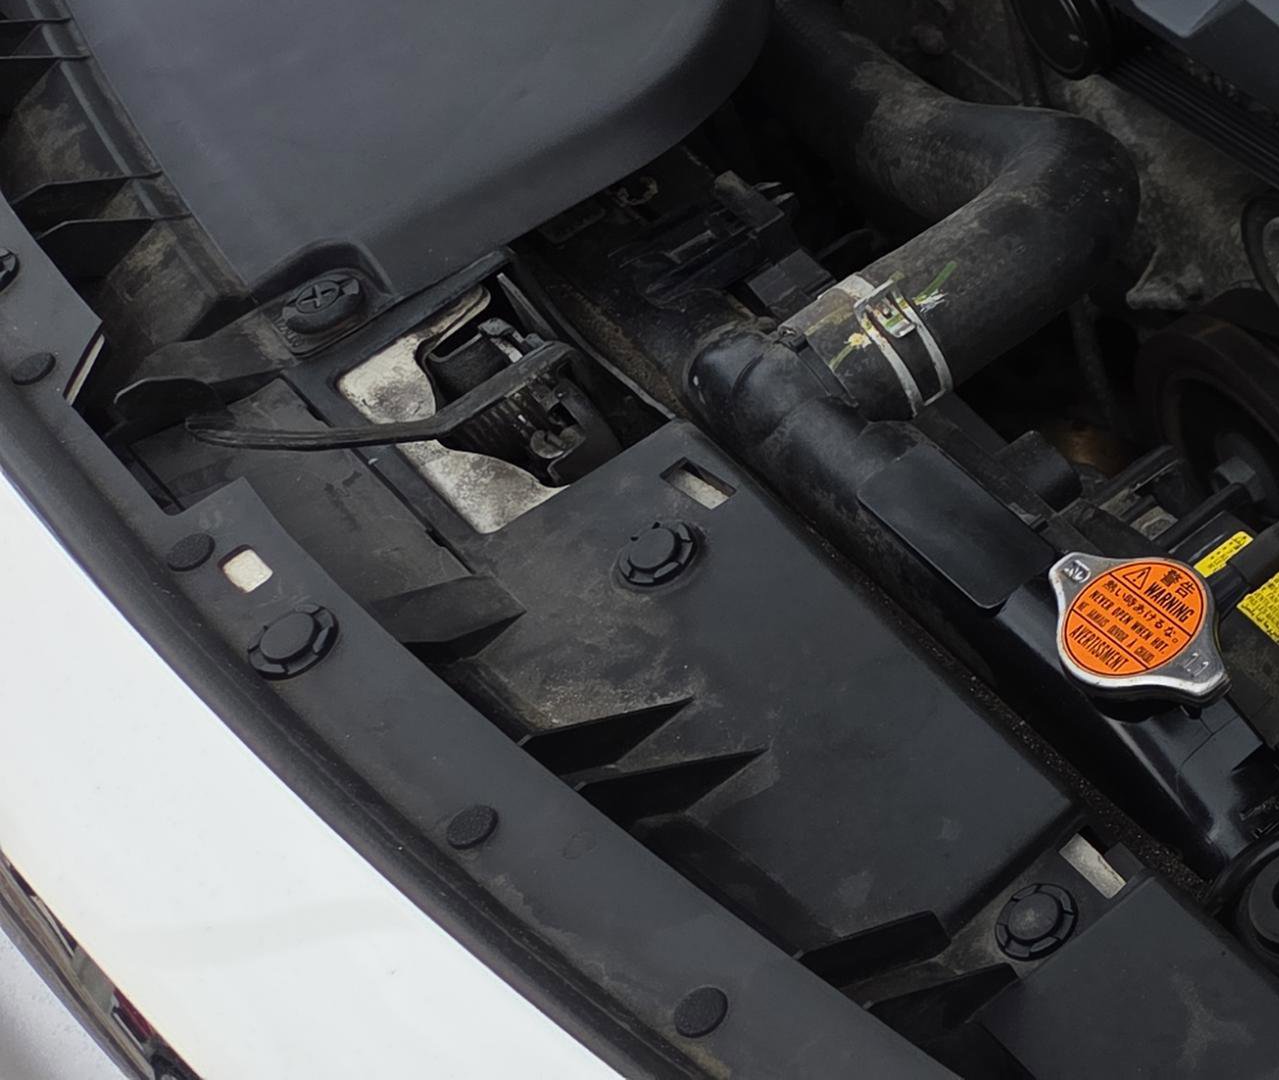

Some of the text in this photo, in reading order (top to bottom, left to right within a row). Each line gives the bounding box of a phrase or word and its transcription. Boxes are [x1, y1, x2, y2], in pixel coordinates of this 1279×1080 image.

[1143, 581, 1195, 623] WARNING
[1160, 569, 1196, 596] 警告
[1088, 590, 1115, 611] NEVER
[1111, 606, 1134, 625] OPEN
[1130, 621, 1154, 641] WHEN
